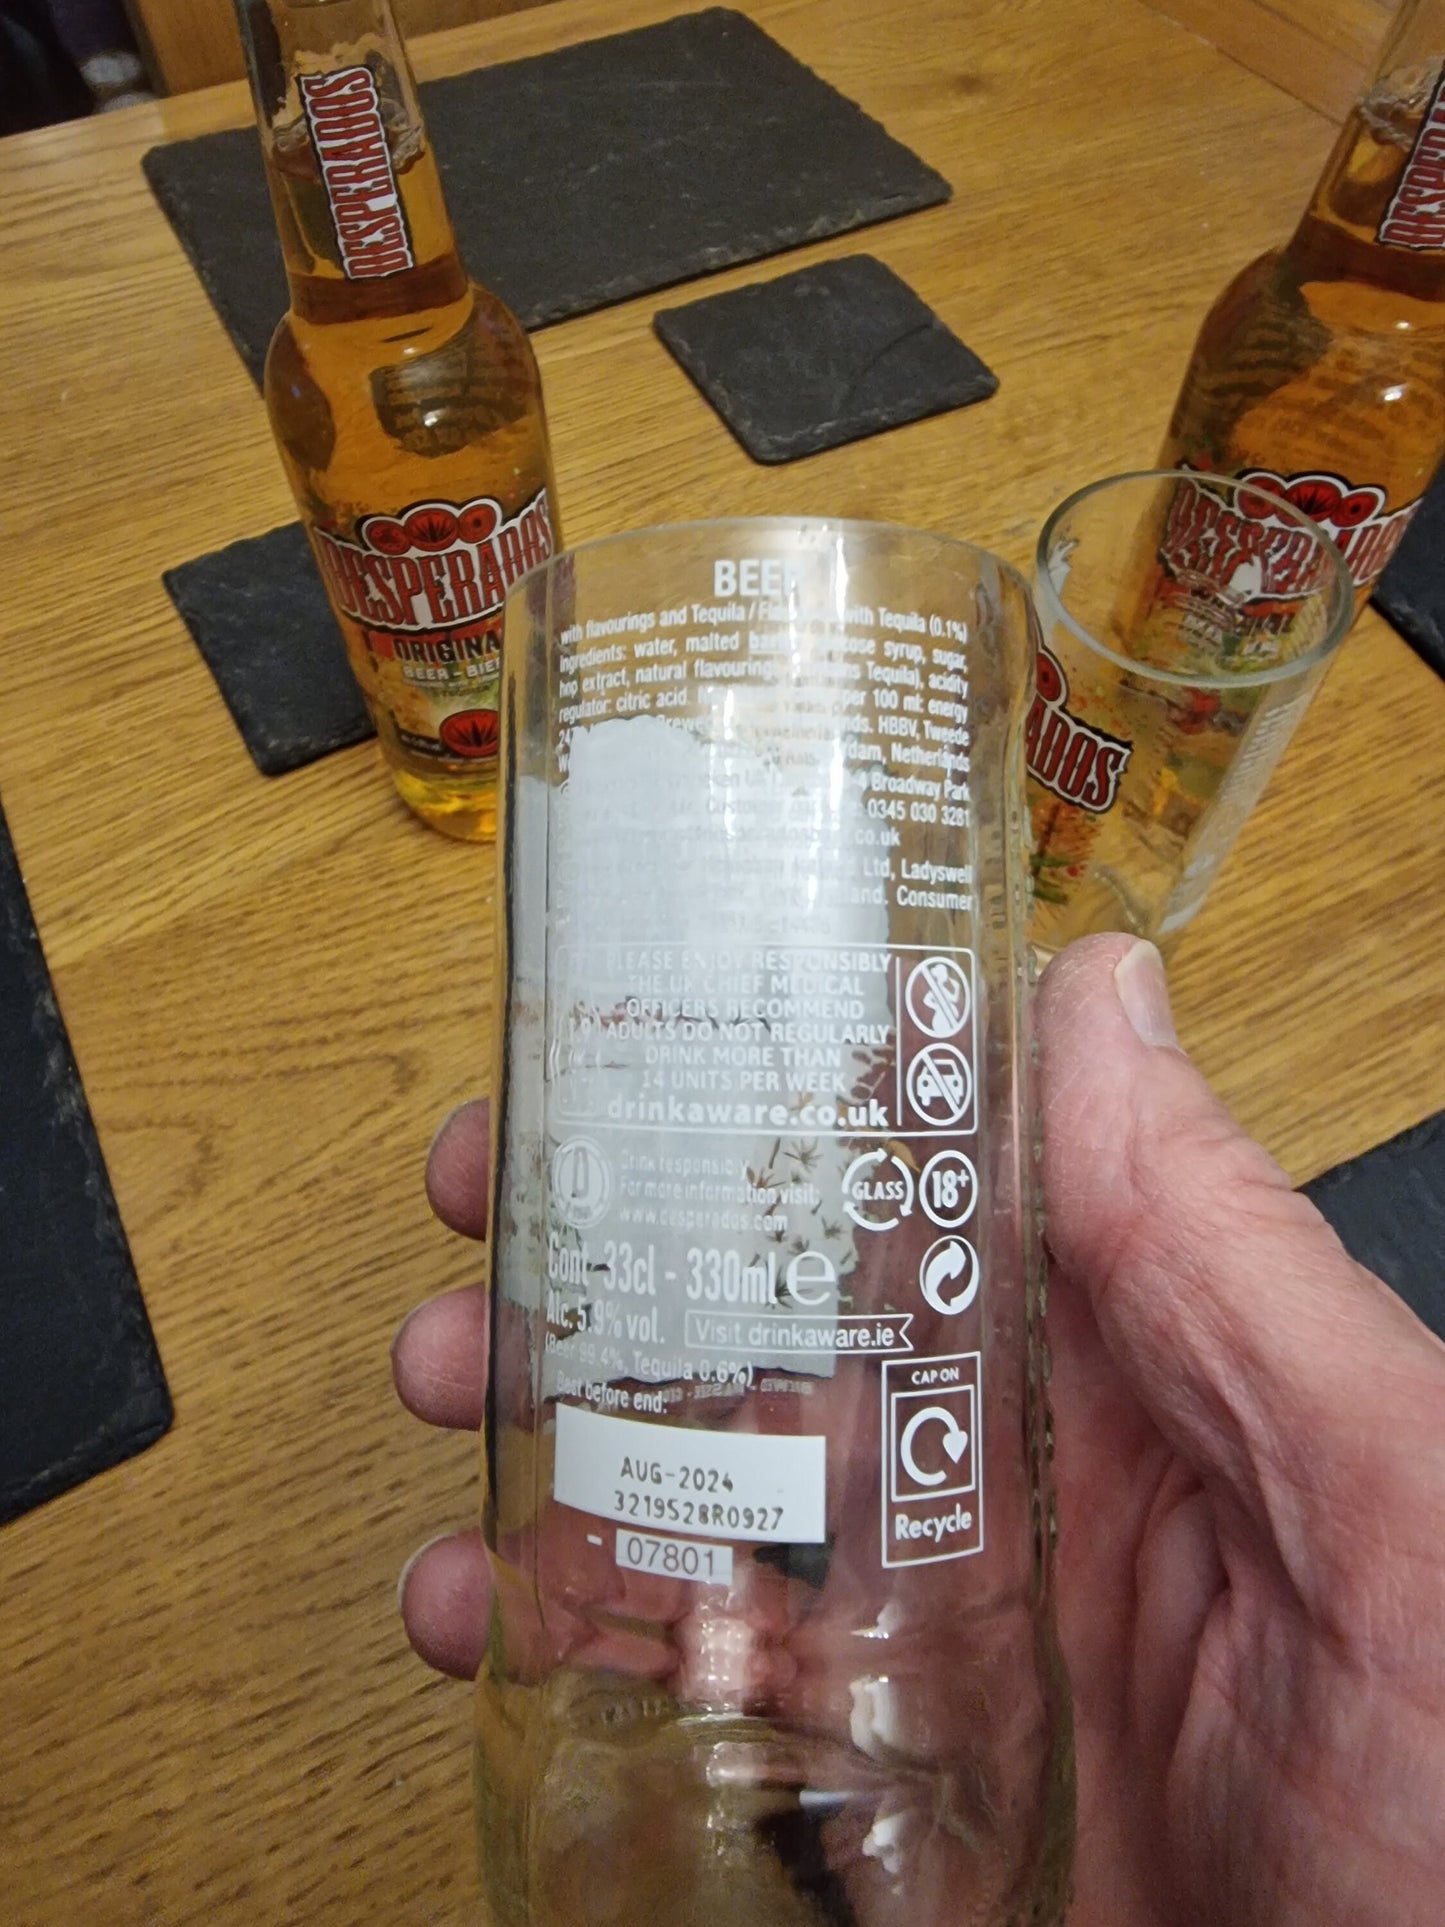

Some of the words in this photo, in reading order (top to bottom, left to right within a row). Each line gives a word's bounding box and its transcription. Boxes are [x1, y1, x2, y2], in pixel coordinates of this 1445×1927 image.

[302, 69, 410, 279] DESPERADOS
[560, 624, 583, 646] with
[586, 611, 655, 640] flavourings
[659, 604, 687, 628] and
[691, 602, 745, 626] Tequila
[878, 606, 926, 633] Tequila
[392, 630, 500, 663] ORIGINA
[559, 645, 626, 674] Ingredients:
[634, 637, 678, 658] water,
[686, 631, 739, 651] malted
[884, 640, 926, 665] syrup,
[933, 648, 968, 674] sugar,
[403, 663, 450, 681] BEER
[559, 679, 578, 699] hop
[583, 669, 630, 694] extract,
[636, 660, 687, 683] natural
[866, 662, 924, 690] Tequila),
[929, 672, 969, 699] acidity
[559, 698, 612, 725] regulator:
[616, 692, 650, 713] citric
[656, 685, 688, 707] acid
[874, 688, 899, 710] 100
[928, 697, 969, 724] energy
[878, 715, 920, 741] HBBV,
[923, 719, 970, 747] Tweede
[891, 742, 971, 772] Netherlands
[872, 771, 941, 801] Broadway
[944, 779, 970, 801] Park
[868, 798, 906, 820] 0345
[910, 802, 937, 823] 030
[863, 858, 896, 881] Ltd,
[901, 858, 974, 885] Ladyswell
[896, 884, 974, 910] Consumer
[752, 952, 893, 973] RESPONSIBLY
[704, 974, 763, 994] CHIEF
[770, 975, 865, 996] MEDICAL
[626, 998, 719, 1018] OFFICERS
[727, 998, 865, 1020] RECOMMEND
[605, 1021, 677, 1042] ADULTS
[682, 1022, 713, 1042] DO
[719, 1023, 763, 1043] NOT
[771, 1023, 891, 1045] REGULARLY
[645, 1045, 706, 1066] DRINK
[713, 1046, 775, 1067] MORE
[780, 1047, 842, 1068] THAN
[671, 1070, 732, 1091] UNITS
[740, 1071, 780, 1092] PER
[787, 1072, 847, 1094] WEEK
[608, 1093, 890, 1128] drinkaware.co.uk
[852, 1181, 905, 1201] GLASS
[932, 1169, 970, 1209] 18+
[603, 1239, 657, 1296] 33cl
[686, 1247, 778, 1304] 330ml
[547, 1288, 574, 1330] Alc.
[577, 1296, 622, 1339] 5.9%
[626, 1306, 666, 1344] vol.
[695, 1317, 742, 1345] Visit
[748, 1322, 895, 1348] drinkaware.ie
[633, 1349, 693, 1382] Tequila
[911, 1370, 937, 1386] CAP
[939, 1366, 960, 1382] ON
[584, 1378, 629, 1409] before
[632, 1391, 668, 1414] end:
[620, 1456, 734, 1493] AUG-2024
[894, 1502, 972, 1544] Recycle
[626, 1536, 716, 1577] 07801
